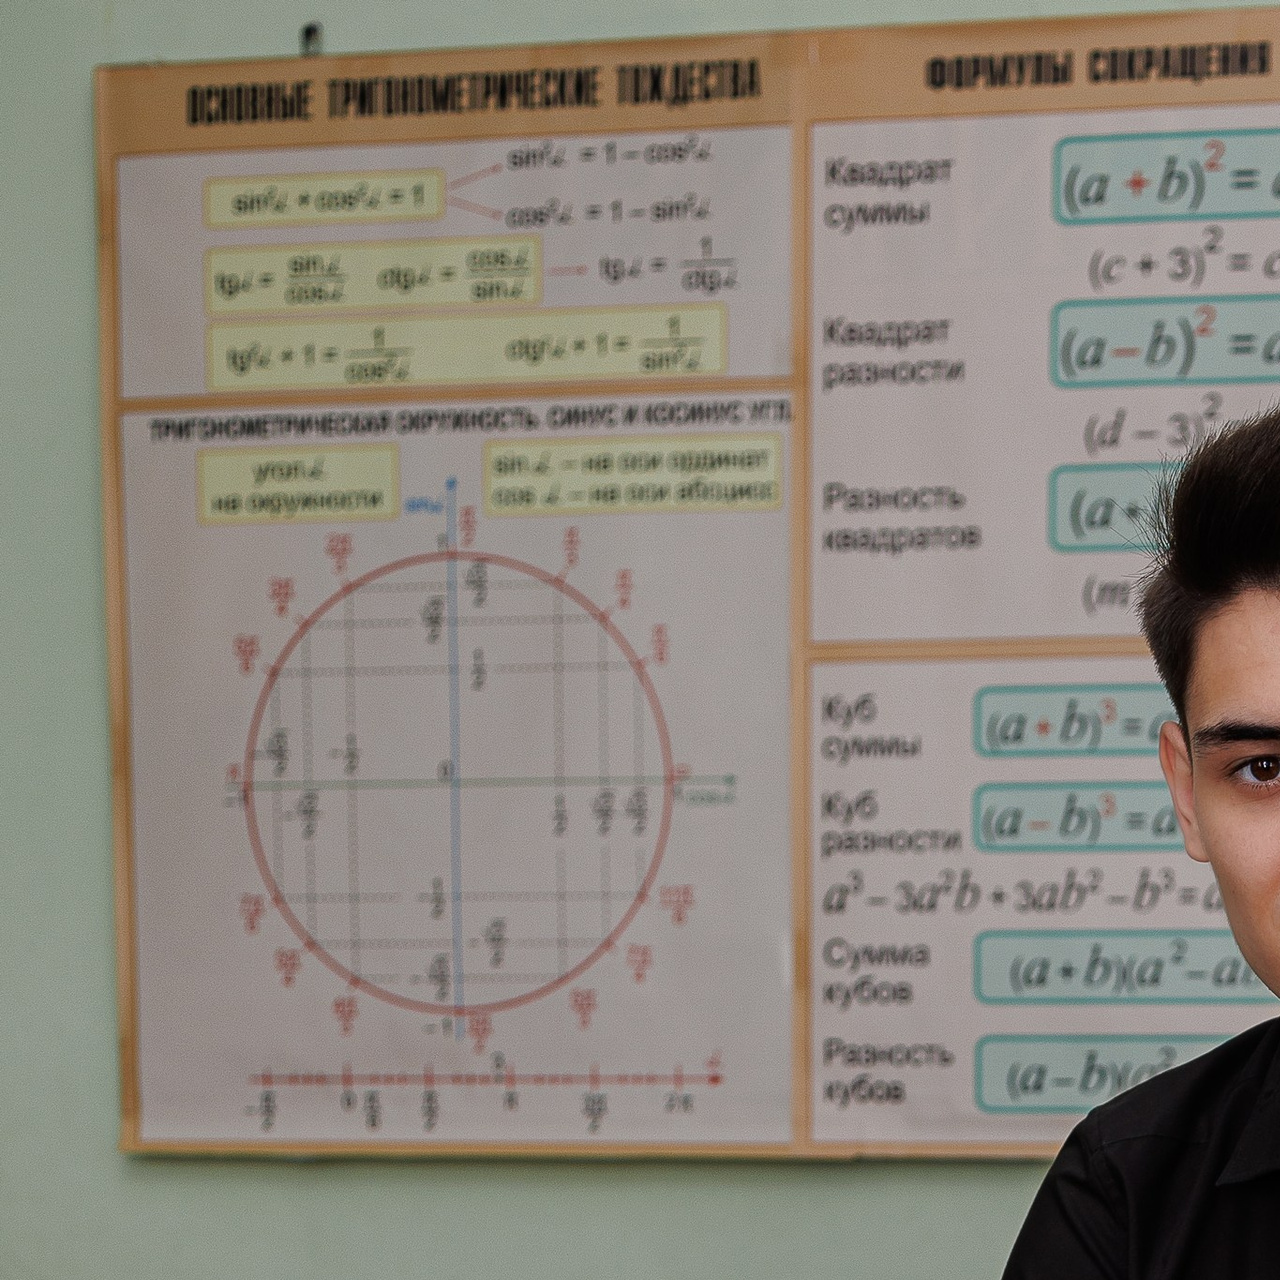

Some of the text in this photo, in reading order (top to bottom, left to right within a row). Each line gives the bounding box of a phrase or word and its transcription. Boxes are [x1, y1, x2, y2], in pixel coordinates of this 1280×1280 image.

[926, 51, 1073, 90] ФОРМУЛЫ
[187, 58, 762, 126] ОСНОВНЫЕ ТРИГОНОМЕТРИЧЕСКИЕ ТОЖДЕСТВА
[823, 156, 953, 189] Квадрат
[823, 200, 931, 232] суммы
[822, 314, 951, 349] Квадрат
[822, 356, 965, 391] разности
[823, 482, 966, 516] Разность
[822, 520, 982, 556] квадратов
[821, 695, 878, 728] Куб
[822, 734, 922, 764] суммы
[821, 790, 879, 824] Куб
[822, 828, 962, 860] разности
[822, 938, 930, 973] Сумма
[823, 978, 914, 1012] кубов
[823, 1037, 955, 1069] Разность
[824, 1076, 907, 1108] кубов
